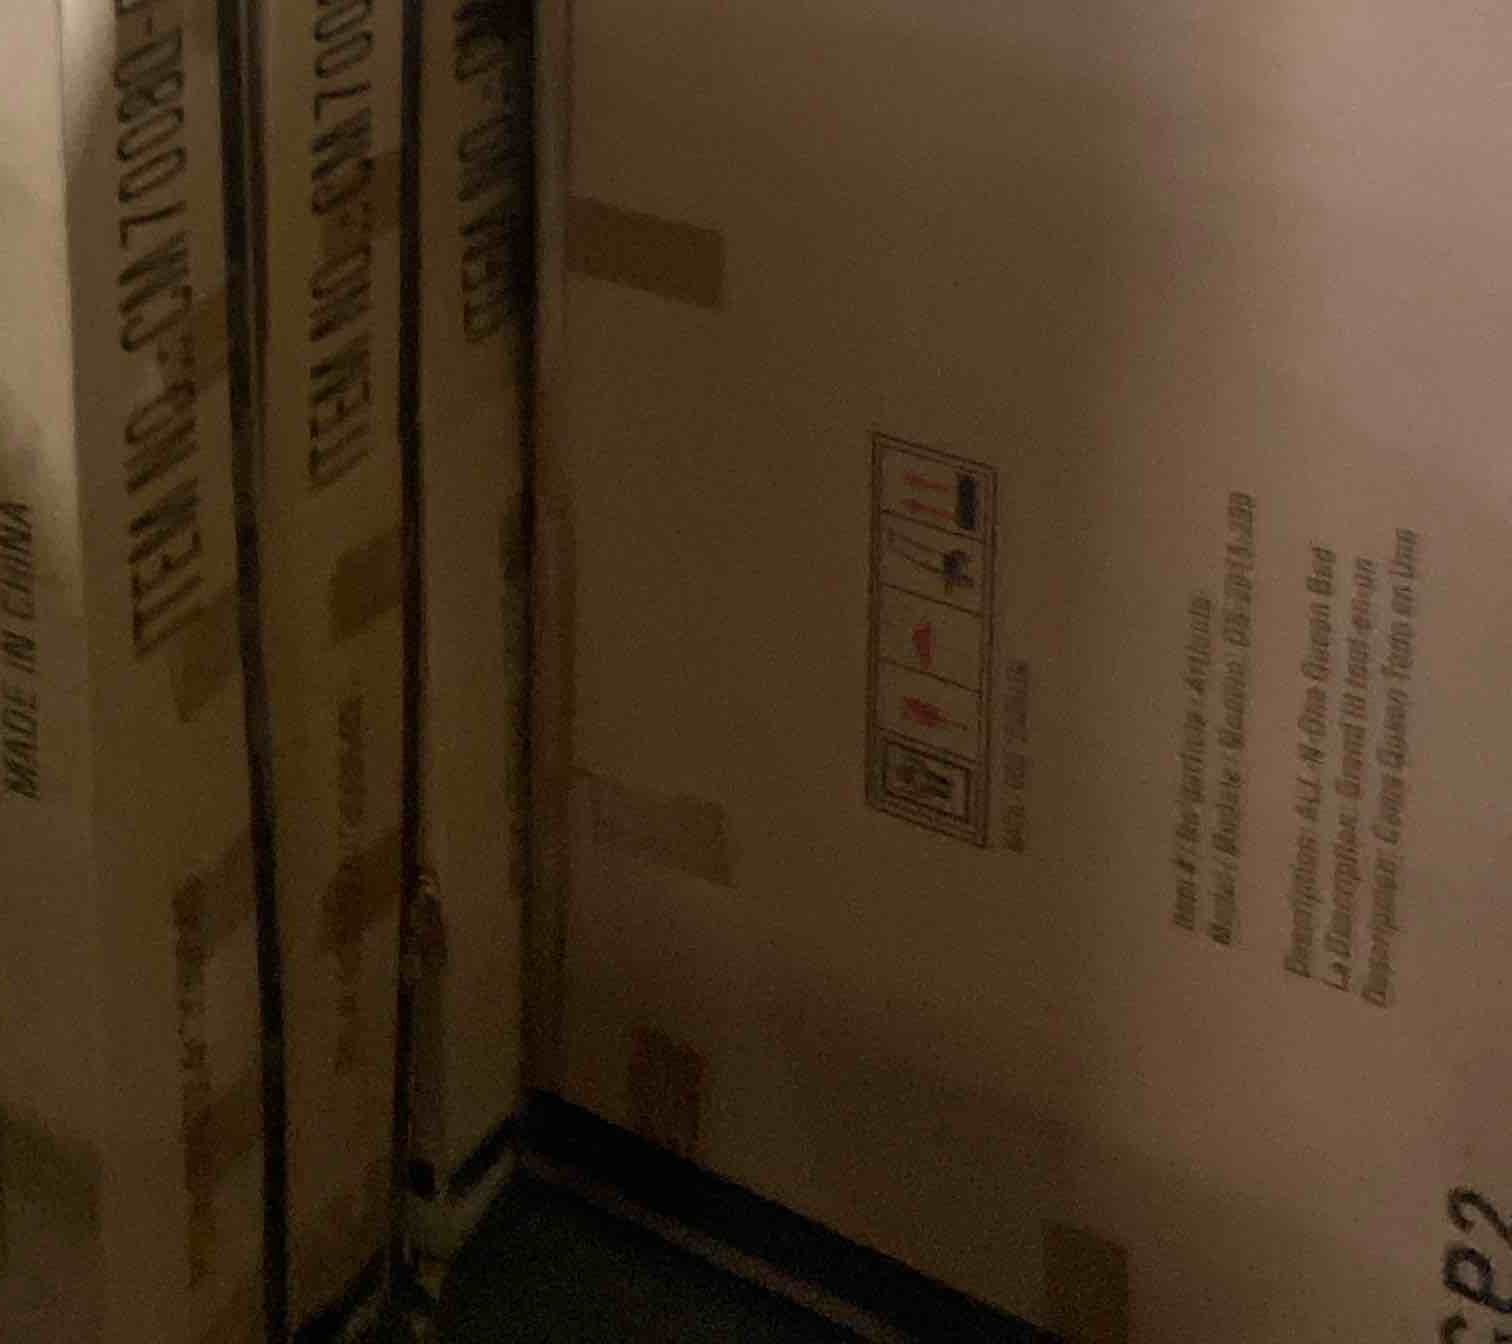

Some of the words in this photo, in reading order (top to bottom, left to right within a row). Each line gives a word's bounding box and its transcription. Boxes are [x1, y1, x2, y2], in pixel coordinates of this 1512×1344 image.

[306, 334, 376, 491] ITEM
[121, 478, 202, 661] ITEM
[1305, 545, 1336, 597] Bed
[0, 631, 37, 675] IN
[0, 692, 41, 801] MADE
